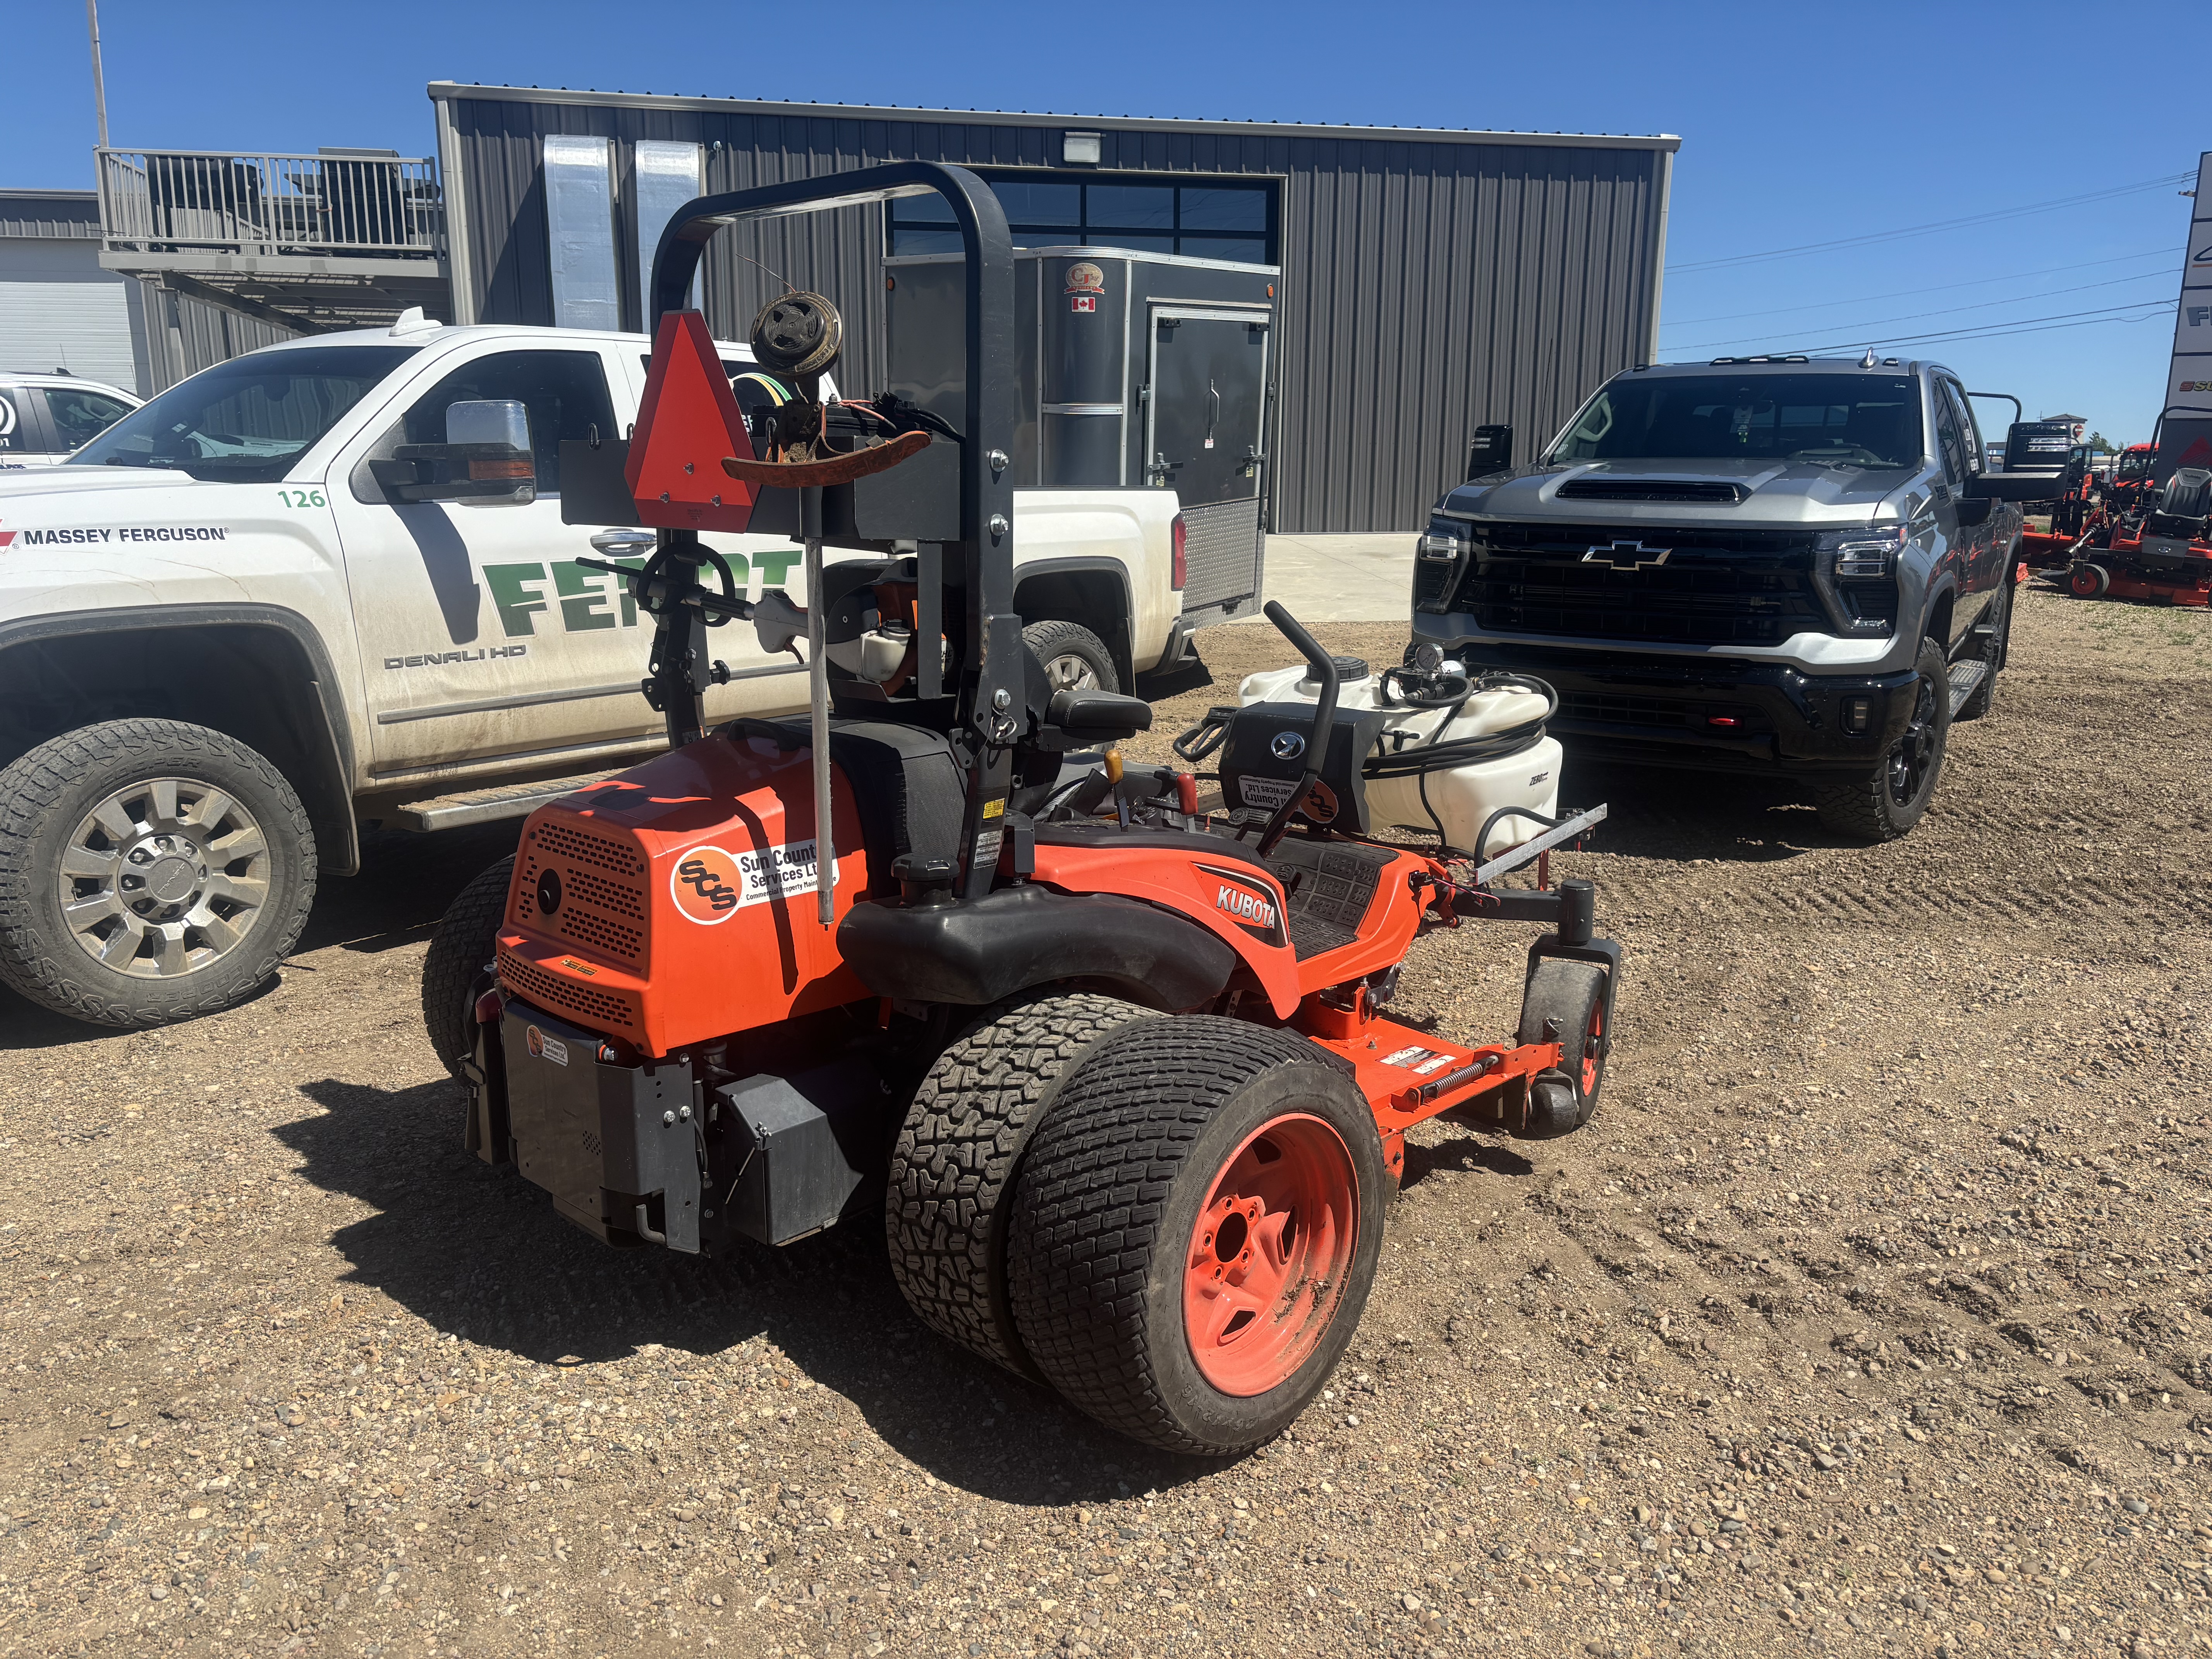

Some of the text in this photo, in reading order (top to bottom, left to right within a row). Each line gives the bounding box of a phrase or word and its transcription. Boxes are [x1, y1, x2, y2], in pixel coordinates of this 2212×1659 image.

[2186, 306, 2212, 326] F
[278, 490, 326, 508] 126
[23, 529, 111, 545] MASSEY
[384, 645, 526, 669] DENALI HD
[100, 756, 201, 787] COOPER
[1529, 773, 1543, 786] ZERO
[1245, 791, 1279, 807] Country
[1246, 783, 1292, 796] Services Ltd.
[740, 844, 817, 873] Sun Count
[157, 862, 185, 895] DENALI
[679, 860, 737, 910] SCS
[750, 862, 818, 888] Services Lt
[746, 876, 836, 901] Commercial Property Mainte
[1216, 884, 1275, 929] KUBOTA
[146, 965, 243, 1003] COOPER
[545, 1046, 558, 1057] Services
[551, 1040, 566, 1054] Country
